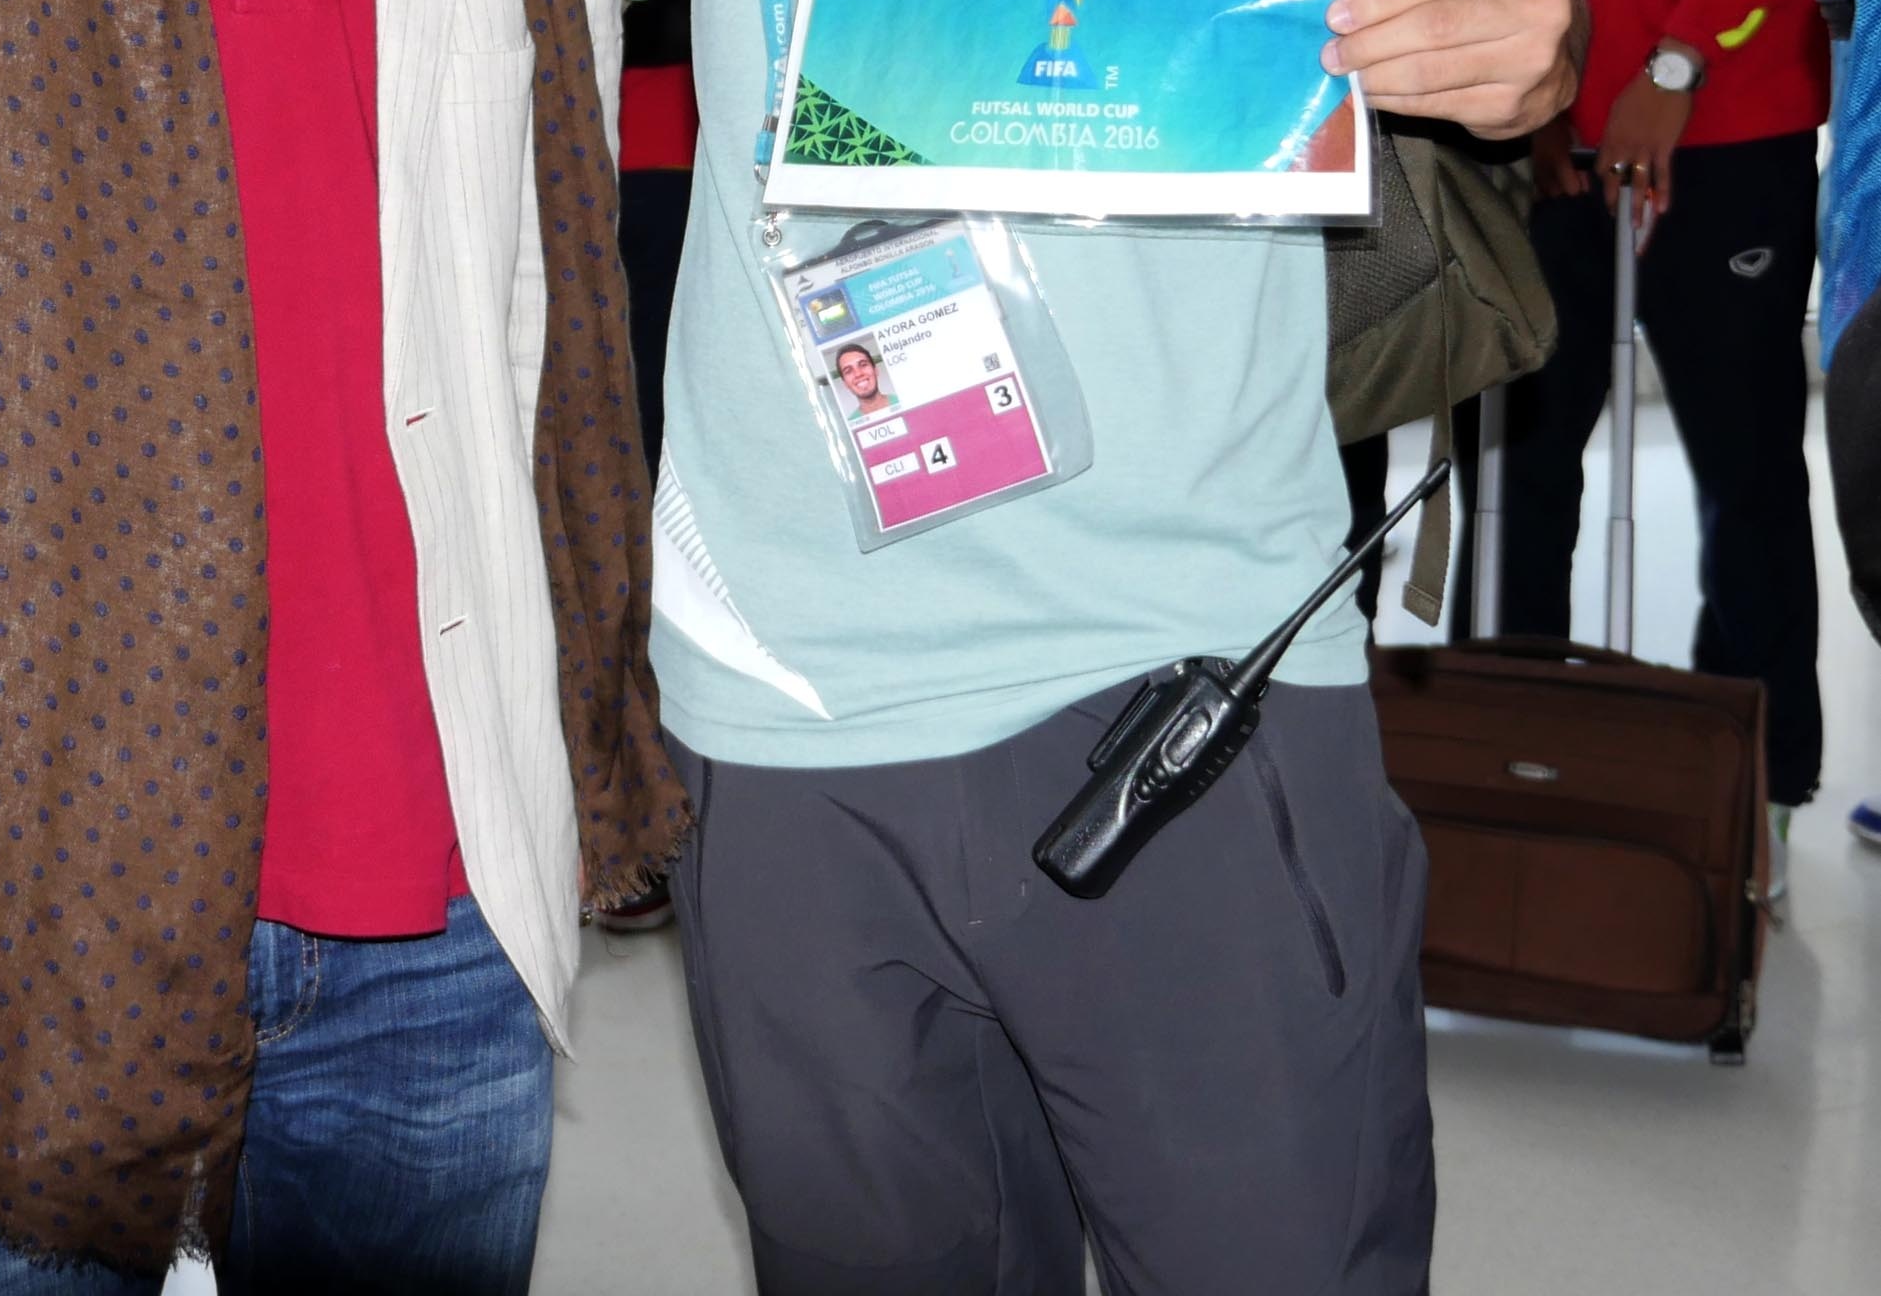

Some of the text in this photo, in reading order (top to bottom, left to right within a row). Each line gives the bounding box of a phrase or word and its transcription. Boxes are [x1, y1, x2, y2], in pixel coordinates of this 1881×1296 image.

[1034, 60, 1077, 77] FIFA
[971, 101, 1139, 119] FUTSAL WORLD CUP
[949, 121, 1160, 150] COLOMBIA 2016
[877, 302, 959, 341] AYORA GOMEZ
[882, 328, 933, 354] Alejandro
[993, 385, 1013, 407] 3
[868, 424, 896, 442] VOL
[931, 443, 948, 465] 4
[884, 463, 905, 477] CLI
